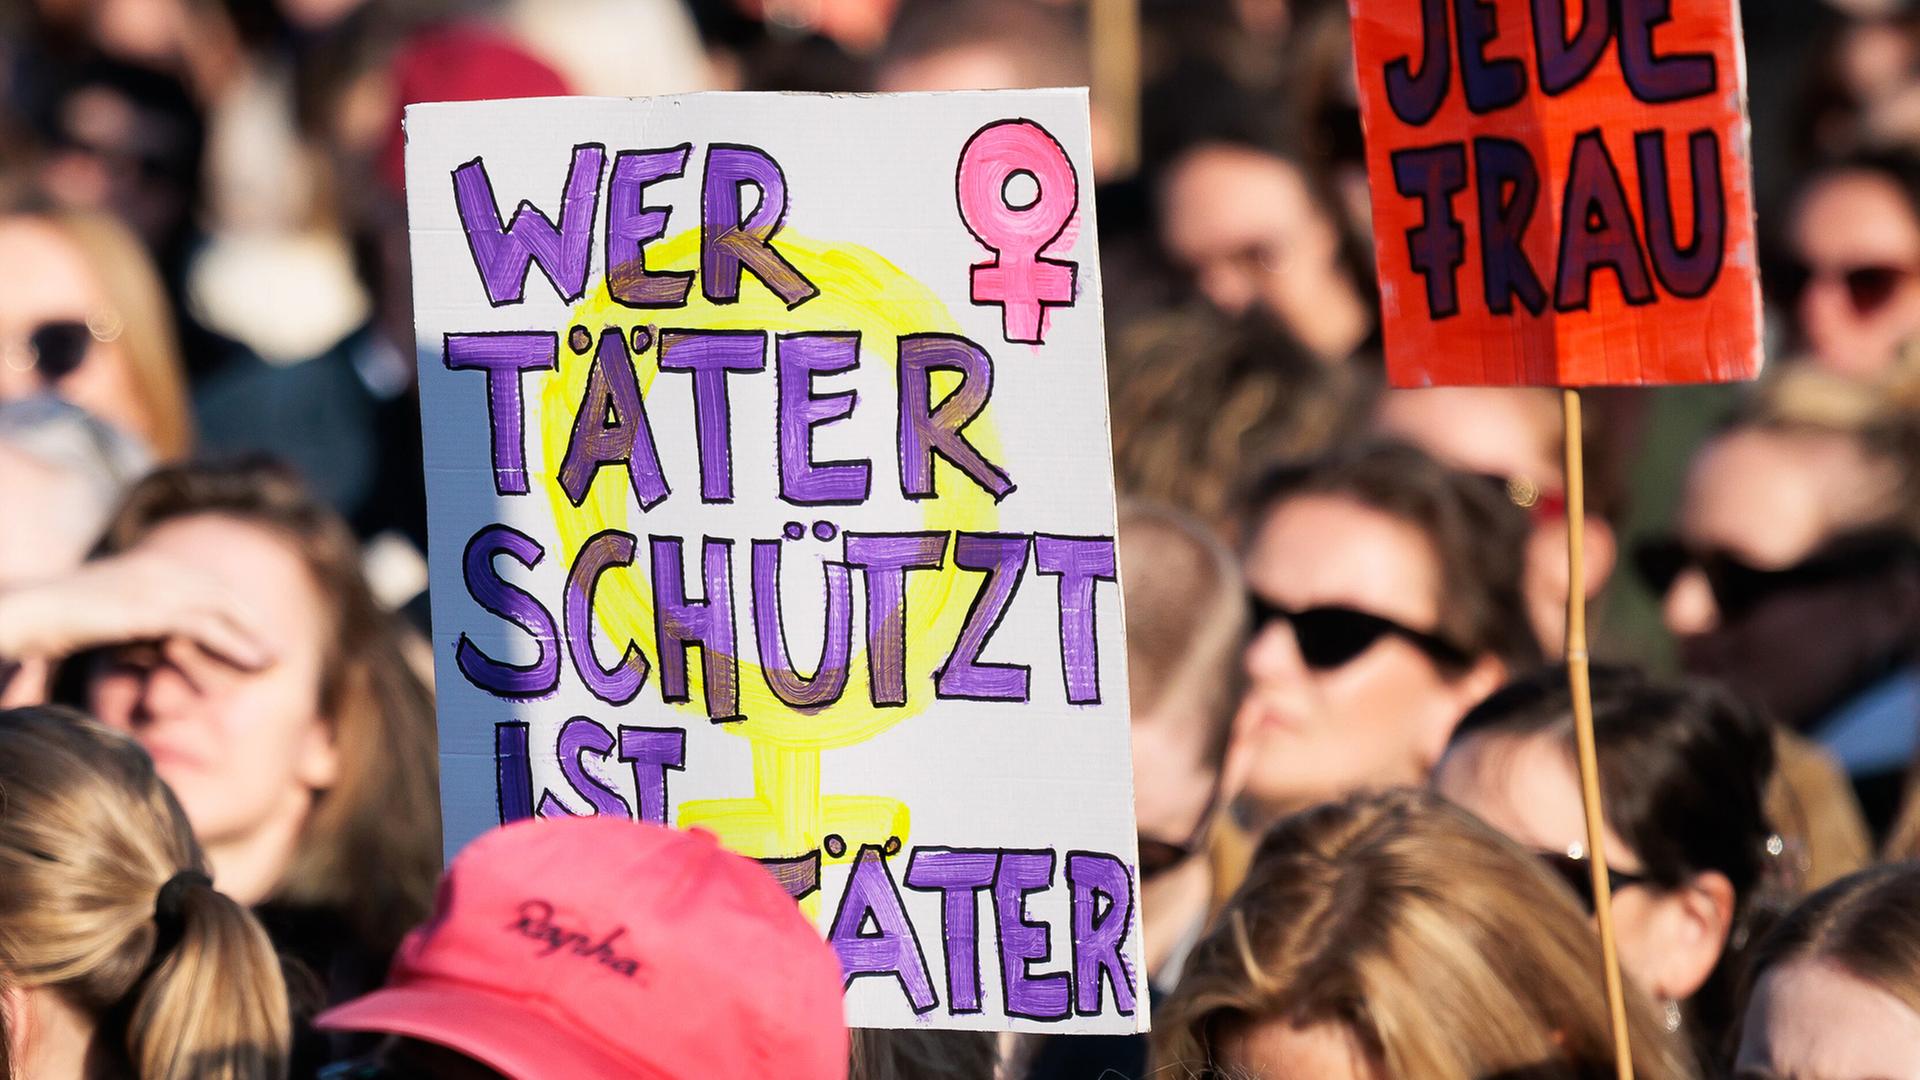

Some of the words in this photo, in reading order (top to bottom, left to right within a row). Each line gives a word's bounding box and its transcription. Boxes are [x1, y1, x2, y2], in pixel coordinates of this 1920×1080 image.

[1384, 0, 1717, 126] JEDE
[452, 142, 821, 311] WER
[1390, 125, 1727, 320] FRAU
[443, 324, 1018, 513] TÄTER
[456, 521, 1118, 724] SCHÜTZT
[496, 716, 687, 828] IST
[506, 898, 639, 978] Rapha
